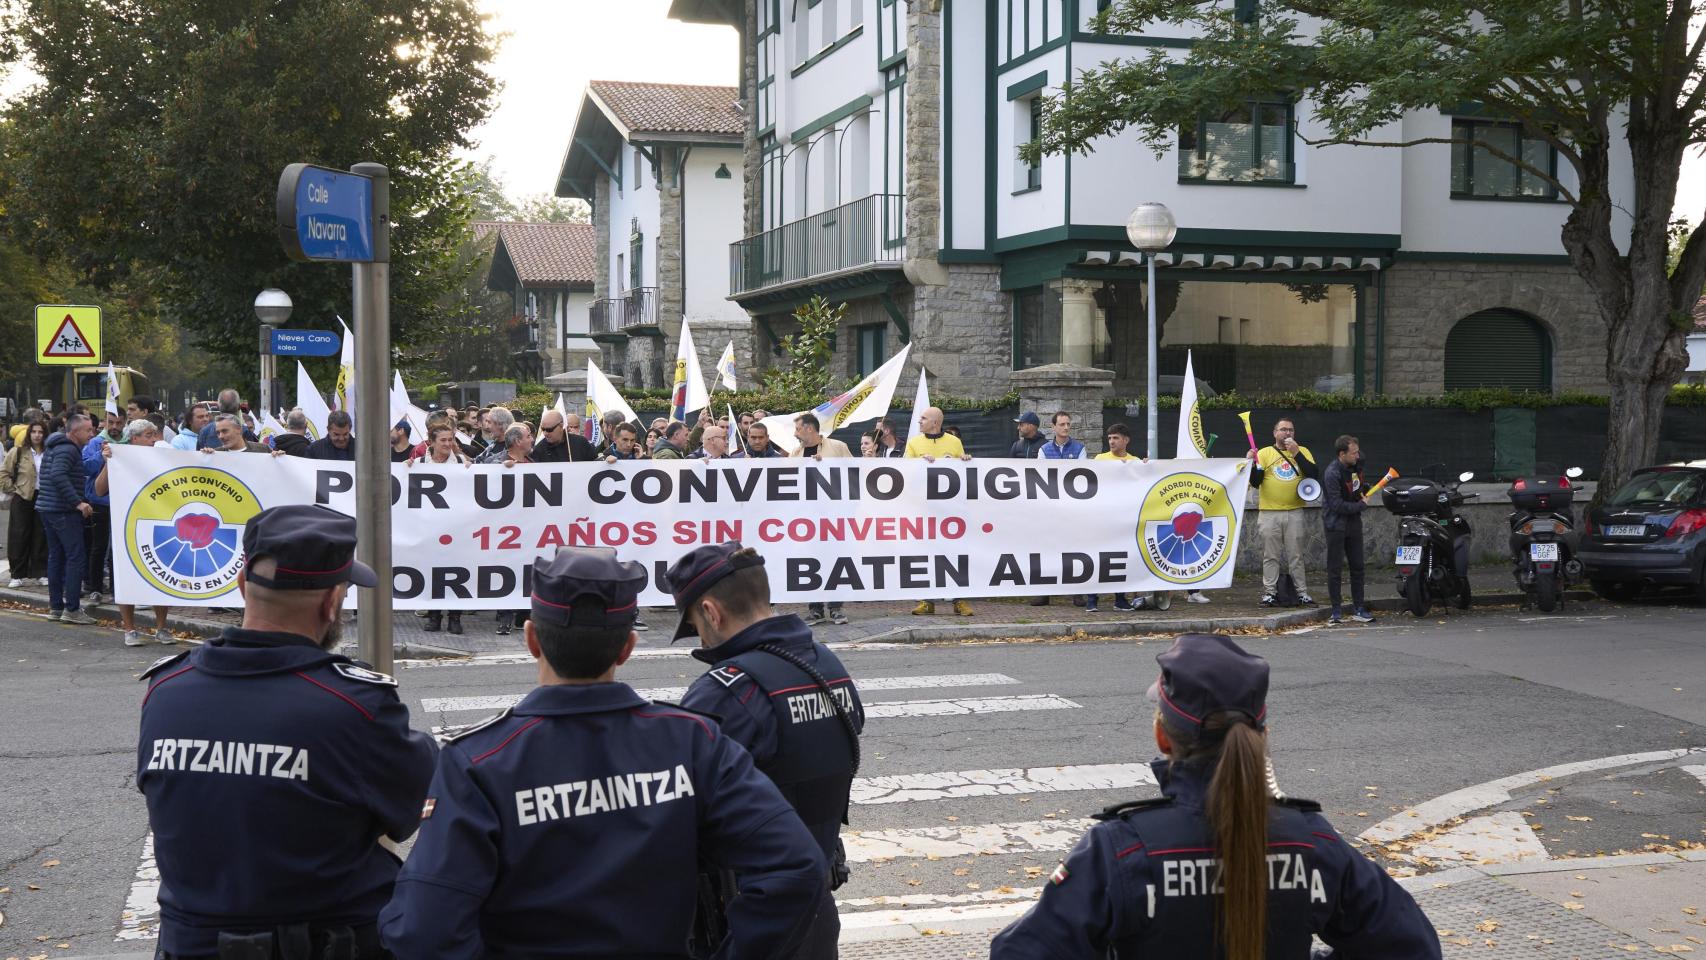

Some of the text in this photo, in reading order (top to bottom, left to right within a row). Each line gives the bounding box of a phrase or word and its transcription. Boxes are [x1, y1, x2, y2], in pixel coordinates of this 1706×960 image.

[307, 183, 329, 204] Calle
[308, 216, 347, 241] Navarra
[278, 334, 331, 343] Nieves Cano
[150, 475, 243, 503] POR UN CONVENIO
[181, 489, 216, 500] DIGNO
[316, 467, 1098, 509] PR UN CONVENIO DIGNO
[1159, 480, 1216, 497] AKORDIO DUIN
[1165, 492, 1213, 507] BATEN ALDE
[473, 516, 966, 550] 12 AÑOS SIN CONVENIO
[205, 577, 222, 589] EN
[223, 553, 245, 581] LUCH
[1196, 535, 1226, 573] ATAZKAN
[787, 555, 969, 591] BATEN
[989, 552, 1128, 586] ALDE
[148, 739, 308, 781] ERTZAINTZA
[515, 764, 695, 826] ERTZAINTZA
[1163, 854, 1307, 897] ERTZTZA
